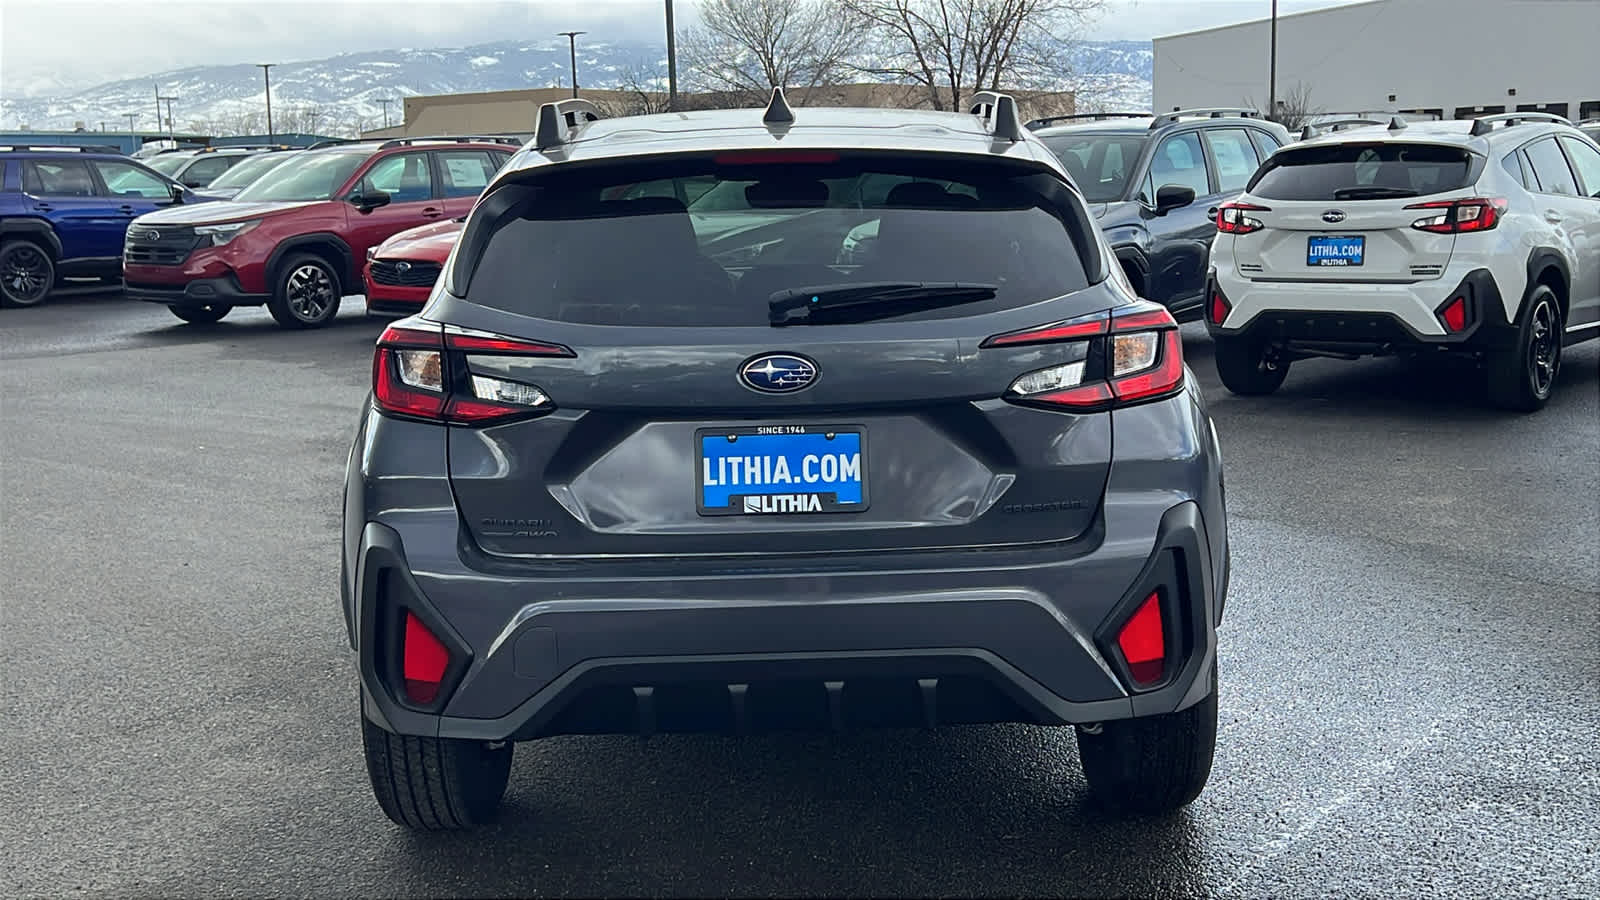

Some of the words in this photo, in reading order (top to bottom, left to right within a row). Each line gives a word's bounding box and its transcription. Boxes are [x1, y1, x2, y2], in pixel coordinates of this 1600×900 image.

[1309, 245, 1362, 257] LITHIA.COM
[757, 426, 784, 435] SINCE
[786, 426, 806, 434] 1946
[703, 453, 861, 486] LITHIA.COM
[761, 494, 823, 513] LITHIA
